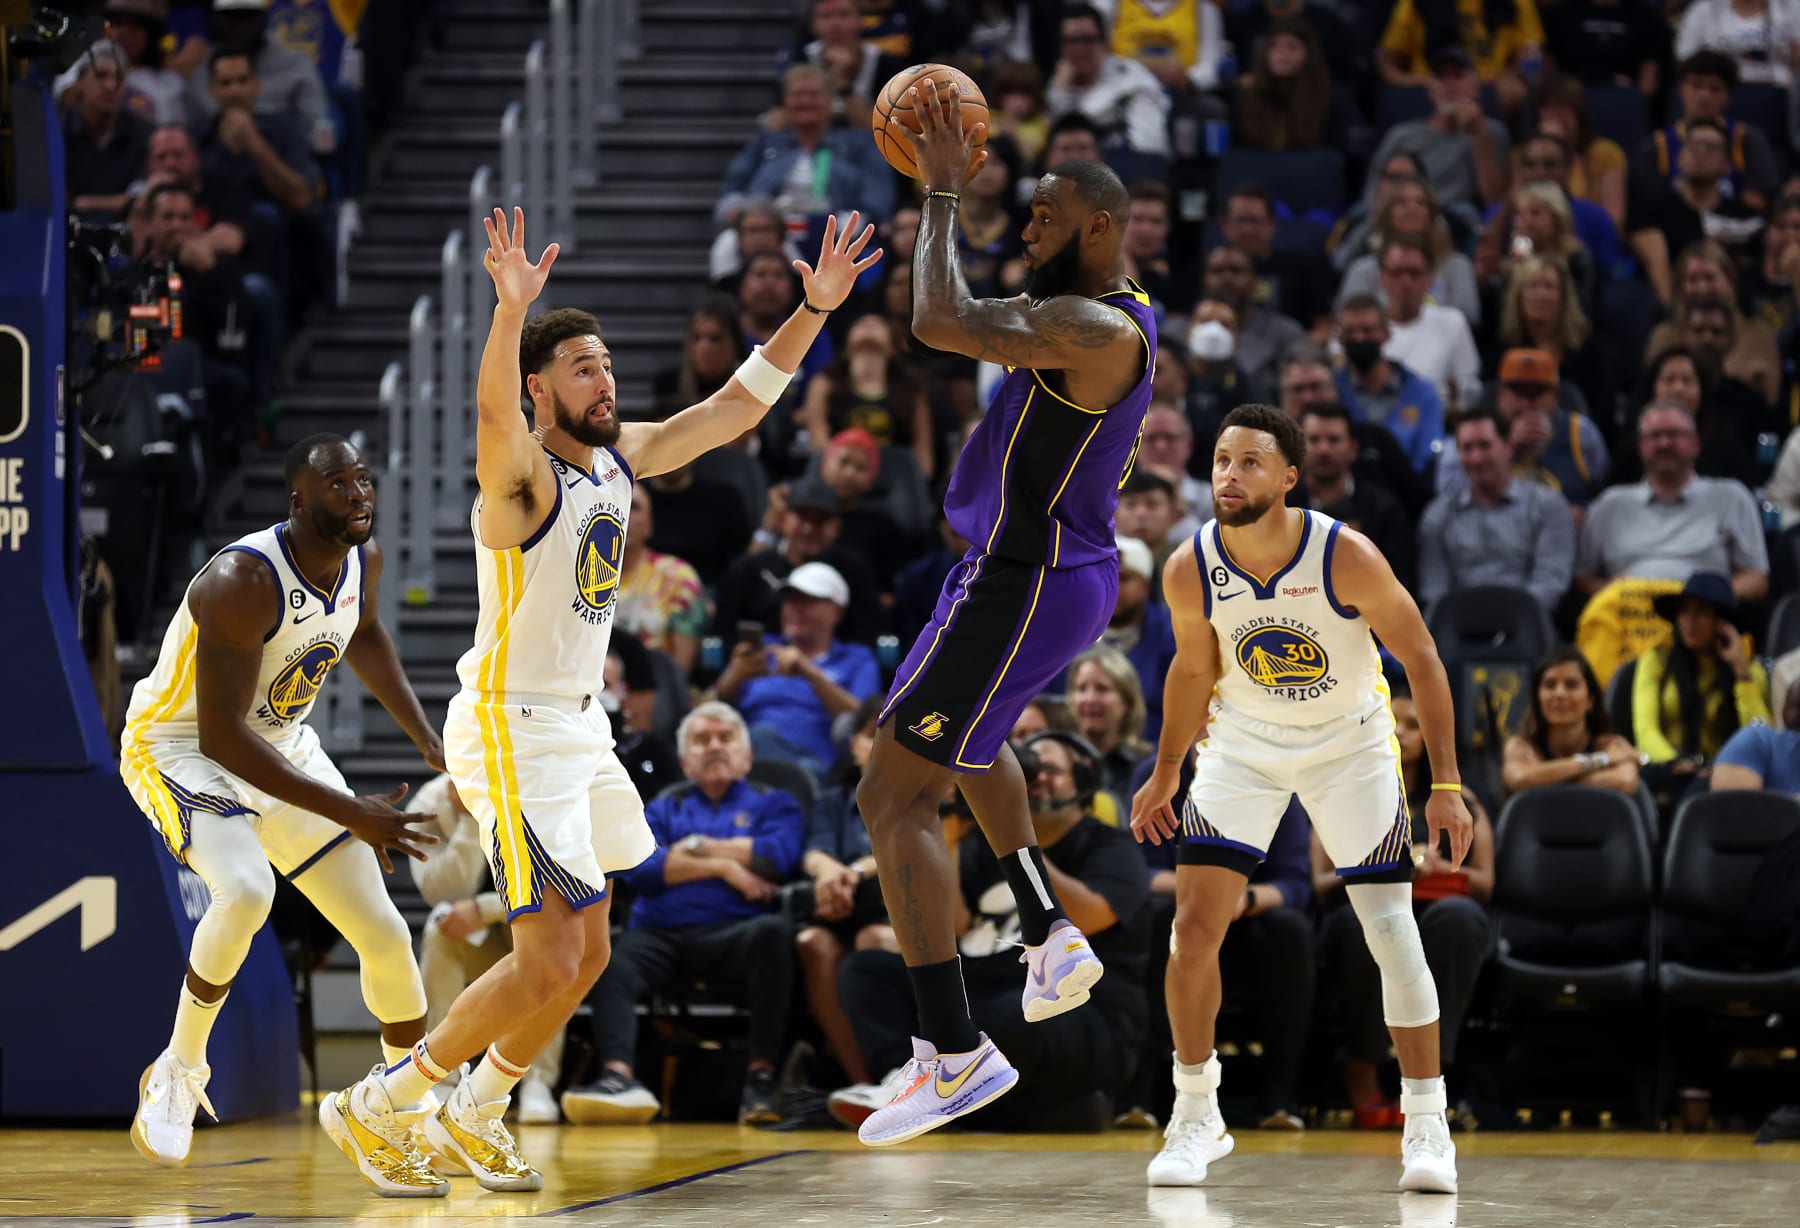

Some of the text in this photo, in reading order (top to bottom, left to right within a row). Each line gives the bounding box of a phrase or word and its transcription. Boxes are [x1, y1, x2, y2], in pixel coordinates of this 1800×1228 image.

[577, 502, 605, 537] GOLDEN
[1215, 569, 1227, 585] 6
[291, 590, 303, 609] 6
[1283, 586, 1319, 597] Rakuten
[1230, 616, 1320, 642] GOLDEN STATE
[284, 631, 327, 662] GOLDEN
[1282, 643, 1316, 661] 30
